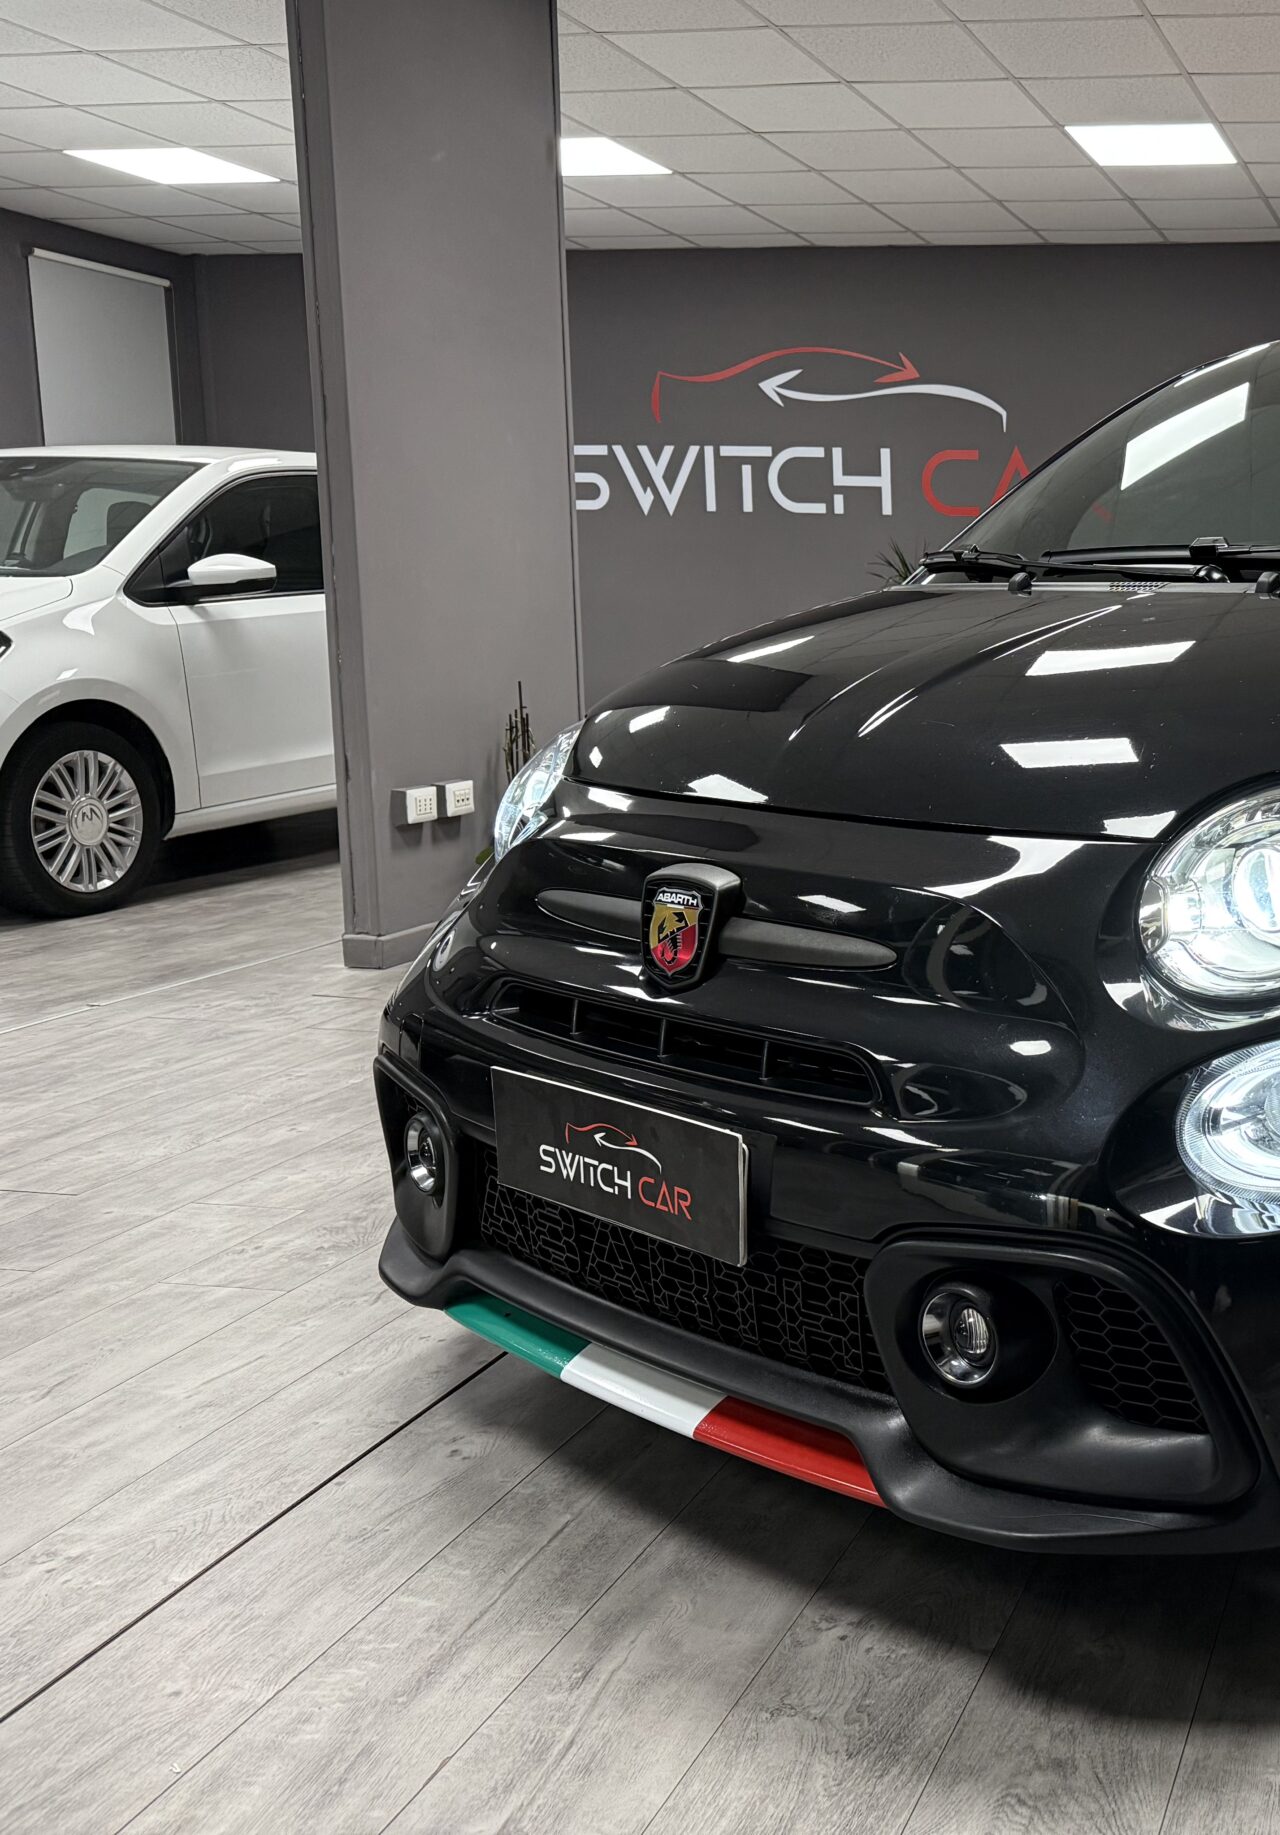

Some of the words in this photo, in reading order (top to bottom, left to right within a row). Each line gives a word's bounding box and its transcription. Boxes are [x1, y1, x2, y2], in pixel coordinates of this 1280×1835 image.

[573, 443, 893, 517] SWITCH
[921, 446, 1034, 516] CA
[656, 892, 698, 906] ABARTH
[539, 1143, 632, 1200] SWITCH
[637, 1175, 693, 1221] CAR
